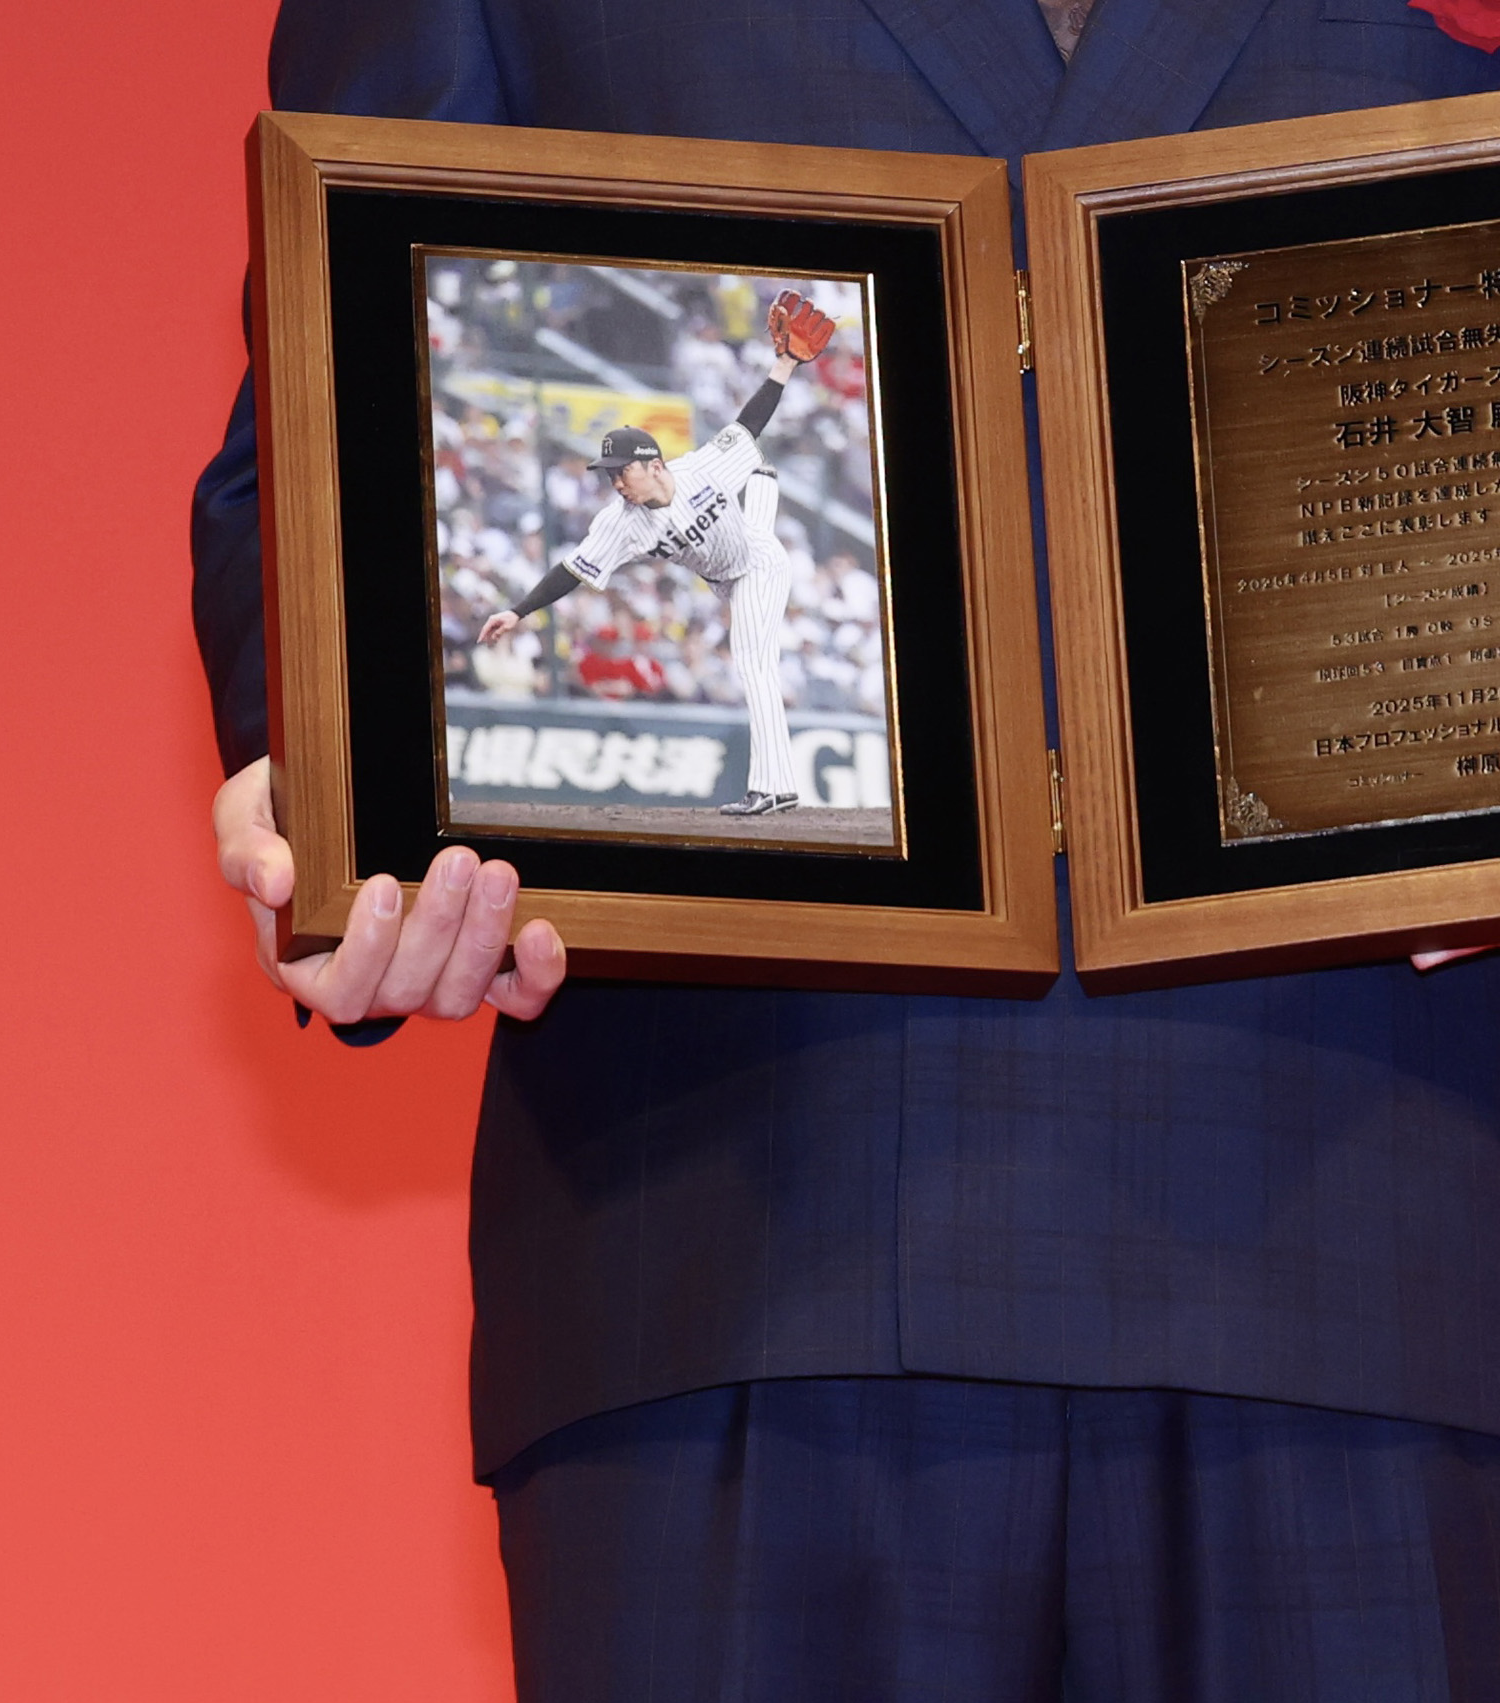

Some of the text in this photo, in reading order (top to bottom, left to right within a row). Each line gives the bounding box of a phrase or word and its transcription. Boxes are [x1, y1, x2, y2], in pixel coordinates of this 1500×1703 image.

[1334, 415, 1398, 449] 石井
[1411, 406, 1474, 440] 大智
[648, 492, 728, 560] Tigers
